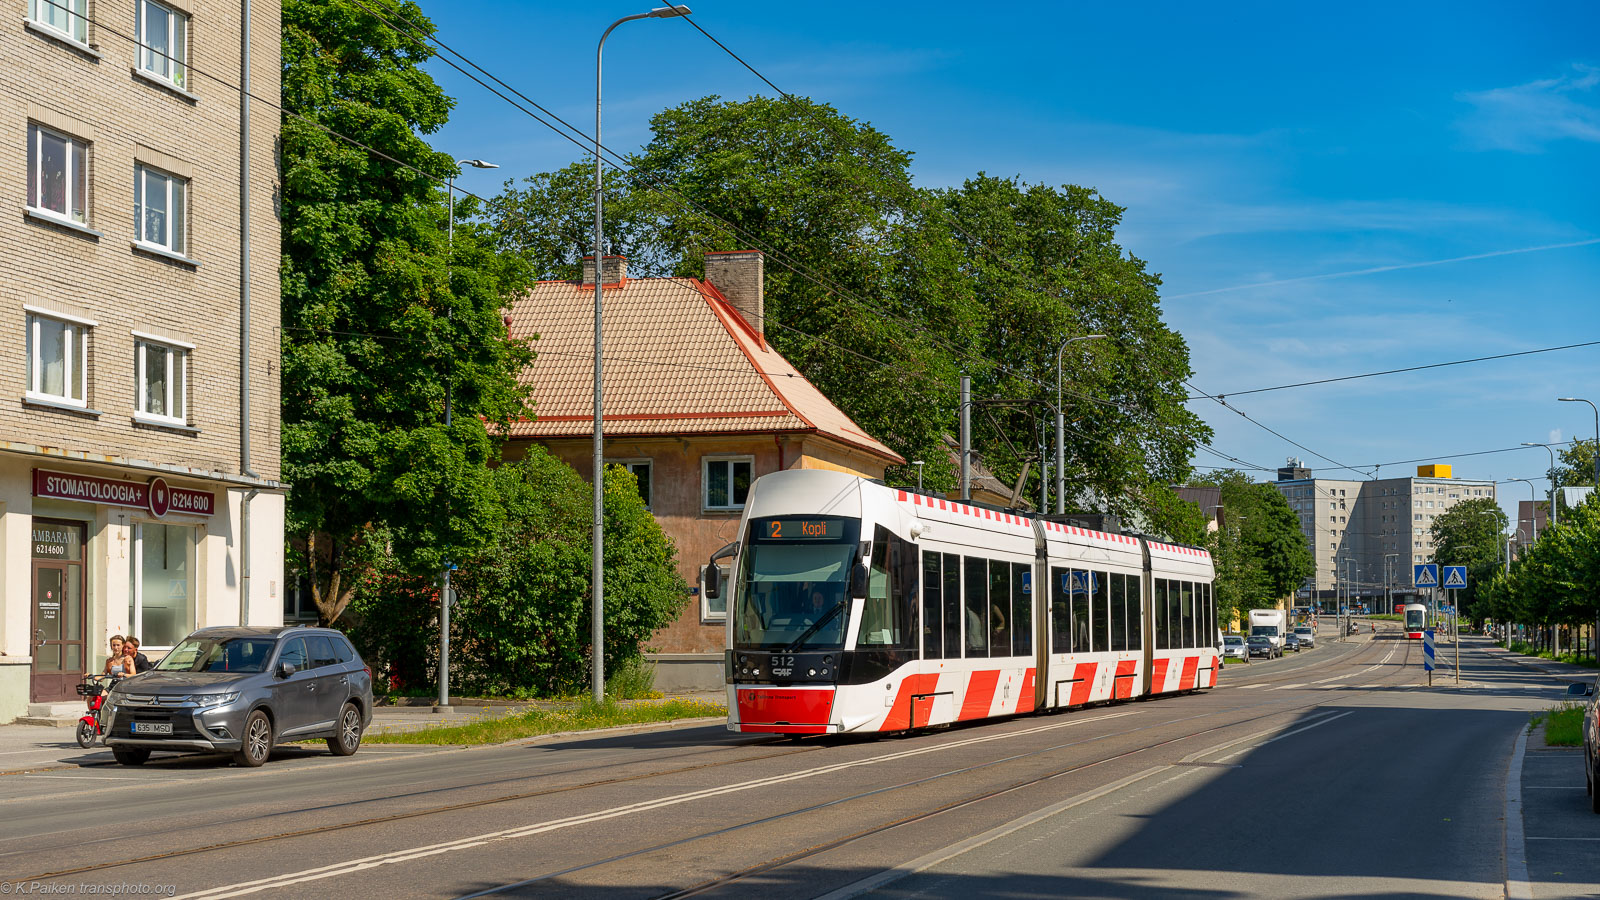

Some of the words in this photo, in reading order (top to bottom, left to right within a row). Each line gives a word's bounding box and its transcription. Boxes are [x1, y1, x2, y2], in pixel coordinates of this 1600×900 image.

[193, 496, 209, 511] 600
[771, 521, 782, 537] 2
[802, 521, 826, 536] Kopli
[32, 529, 76, 544] AMBARAVI
[36, 544, 64, 555] 6214600
[771, 656, 794, 666] 512
[137, 724, 150, 732] 635
